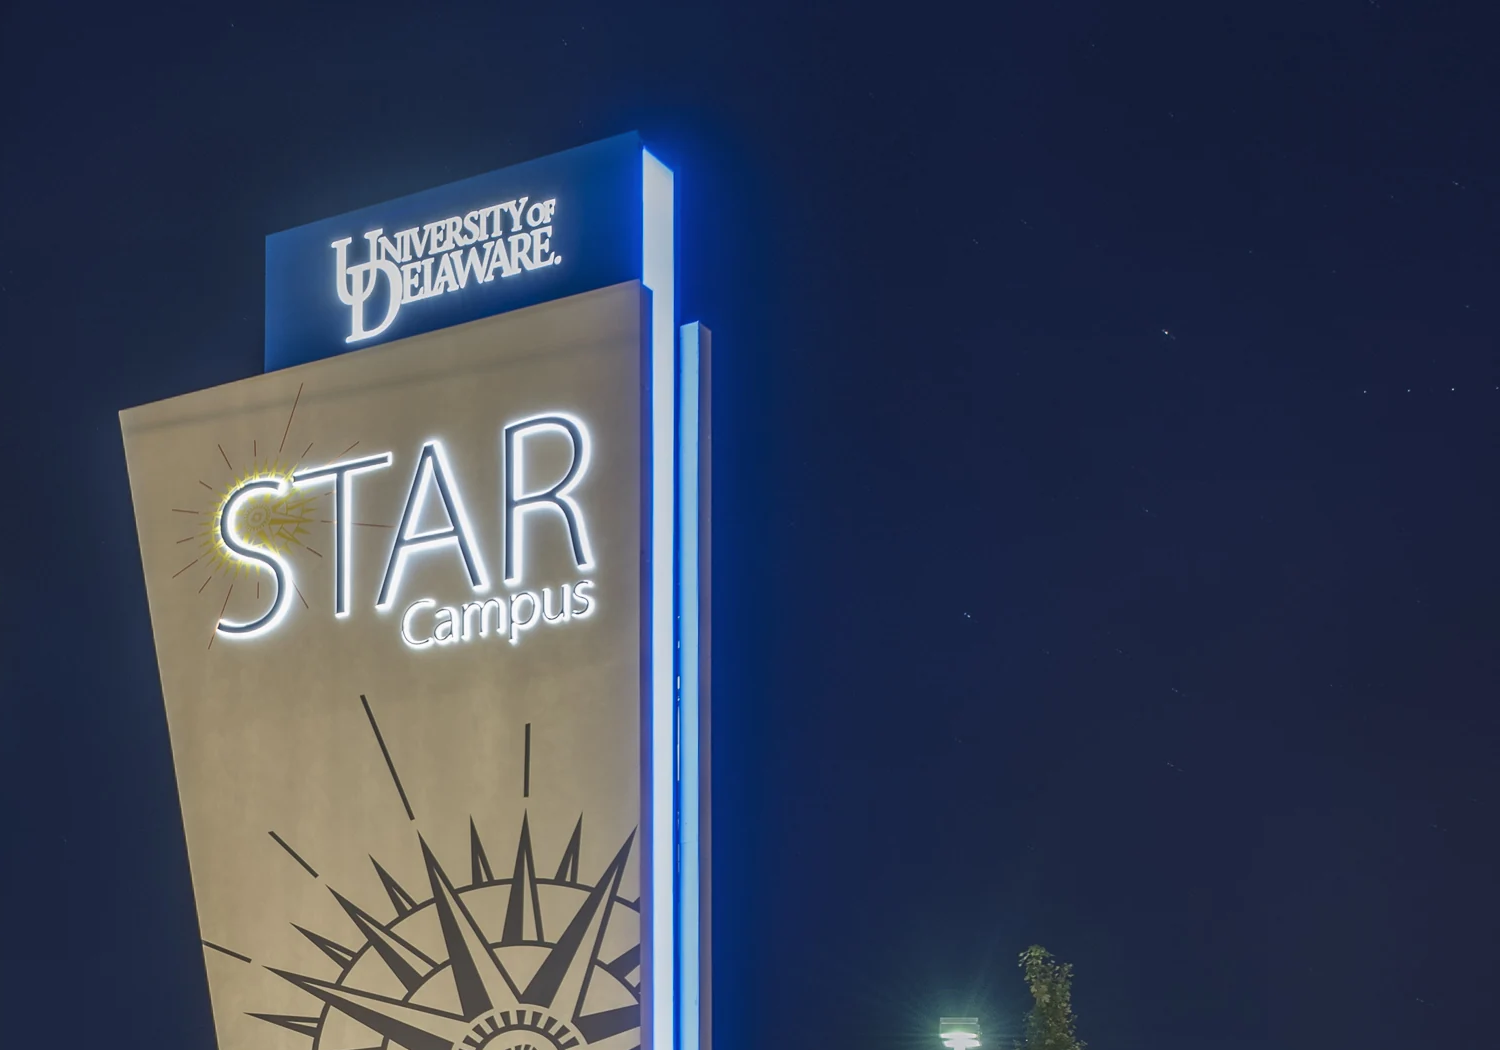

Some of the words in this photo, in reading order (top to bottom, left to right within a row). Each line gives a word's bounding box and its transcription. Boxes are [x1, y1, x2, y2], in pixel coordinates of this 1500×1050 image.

[331, 197, 528, 306] UNIVERSITY
[526, 199, 556, 228] OF
[216, 413, 593, 638] STAR
[401, 579, 595, 645] Campus
